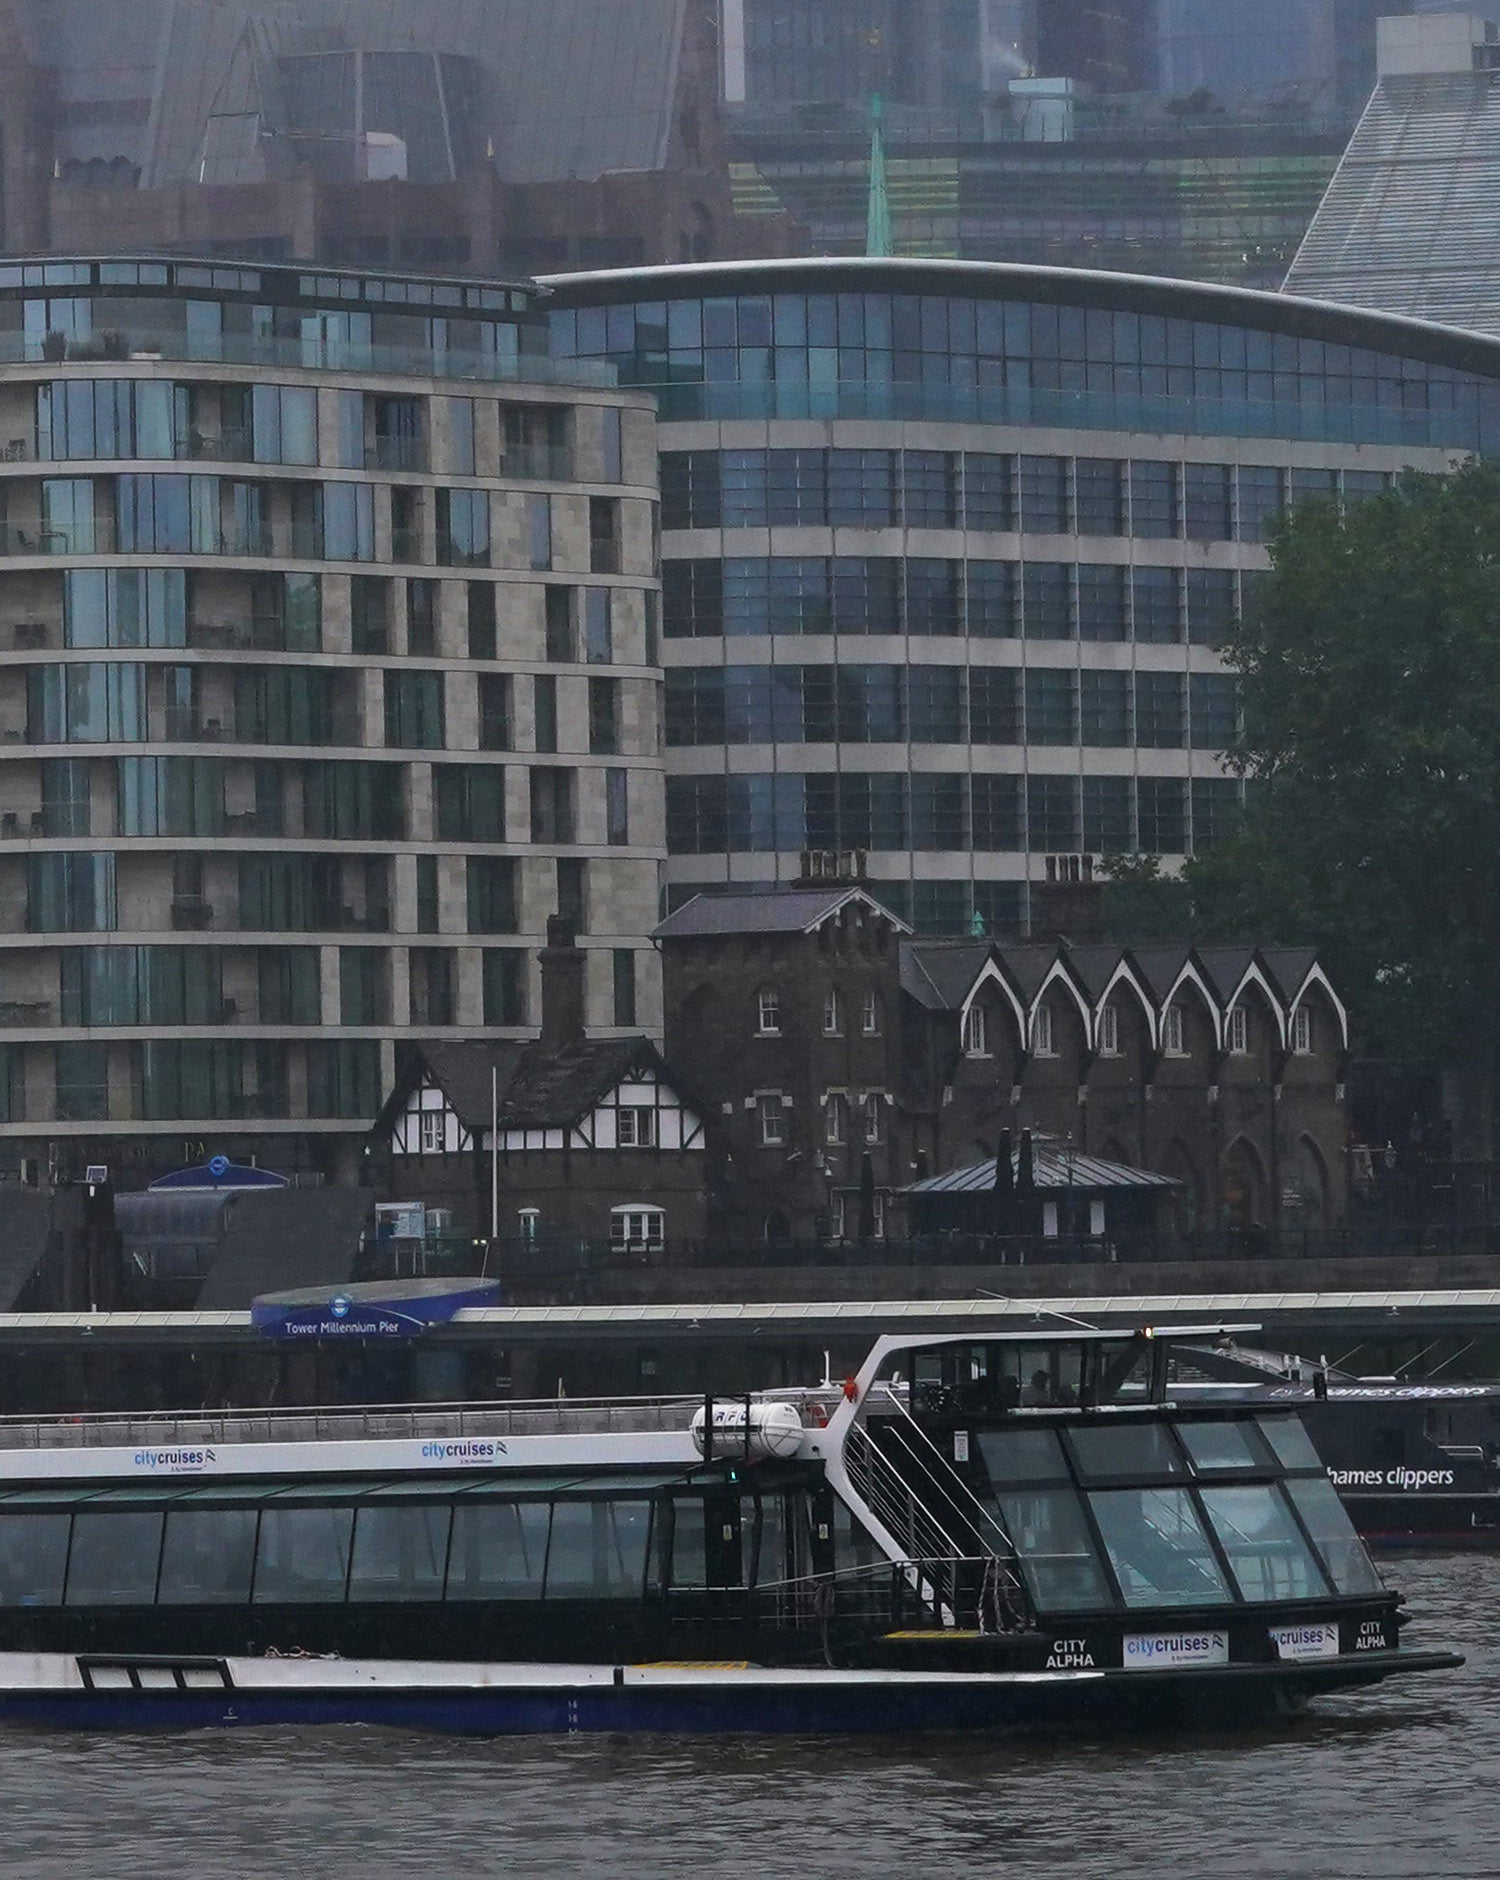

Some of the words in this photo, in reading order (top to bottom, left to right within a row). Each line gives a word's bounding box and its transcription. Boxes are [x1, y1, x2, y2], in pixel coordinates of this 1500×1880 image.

[285, 1322, 317, 1334] Tower
[320, 1321, 376, 1333] Millennium
[379, 1321, 399, 1333] Pier
[1395, 1385, 1492, 1398] clippers
[421, 1441, 494, 1460] citycruises
[134, 1449, 204, 1468] citycruises
[1386, 1467, 1455, 1490] clippers
[1360, 1622, 1382, 1635] CITY
[1053, 1639, 1087, 1654] CITY
[1127, 1634, 1210, 1658] citycruises
[1355, 1635, 1387, 1650] ALPHA
[1046, 1654, 1095, 1668] ALPHA
